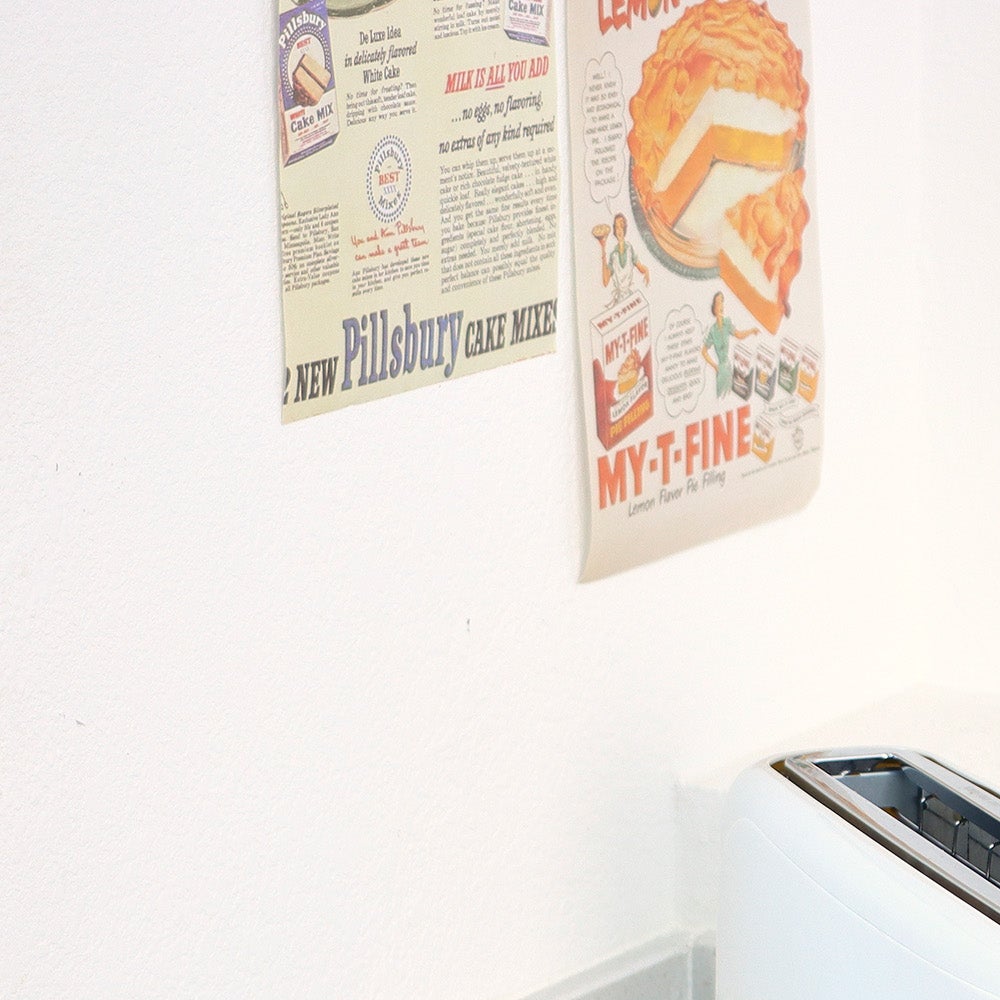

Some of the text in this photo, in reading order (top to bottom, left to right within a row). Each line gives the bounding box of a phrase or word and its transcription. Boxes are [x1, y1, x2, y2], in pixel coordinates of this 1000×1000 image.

[529, 3, 544, 16] MIX
[279, 11, 327, 48] Pillsbury
[359, 26, 401, 45] De Luxe Idea
[344, 41, 418, 67] in delicately flavored
[363, 64, 401, 84] White Cake
[445, 55, 550, 94] MILK IS ALL YOU ADD
[290, 114, 314, 133] Cake
[316, 103, 334, 122] MIX
[474, 102, 492, 123] eggs,
[494, 101, 504, 115] no
[439, 115, 555, 154] no extras of any kind required
[374, 146, 404, 173] Pillsbury
[379, 171, 401, 186] BEST
[294, 356, 339, 403] NEW
[341, 303, 464, 391] Pillsbury
[464, 313, 507, 360] CAKE
[628, 470, 726, 517] Lemon Flavor Pie Filling
